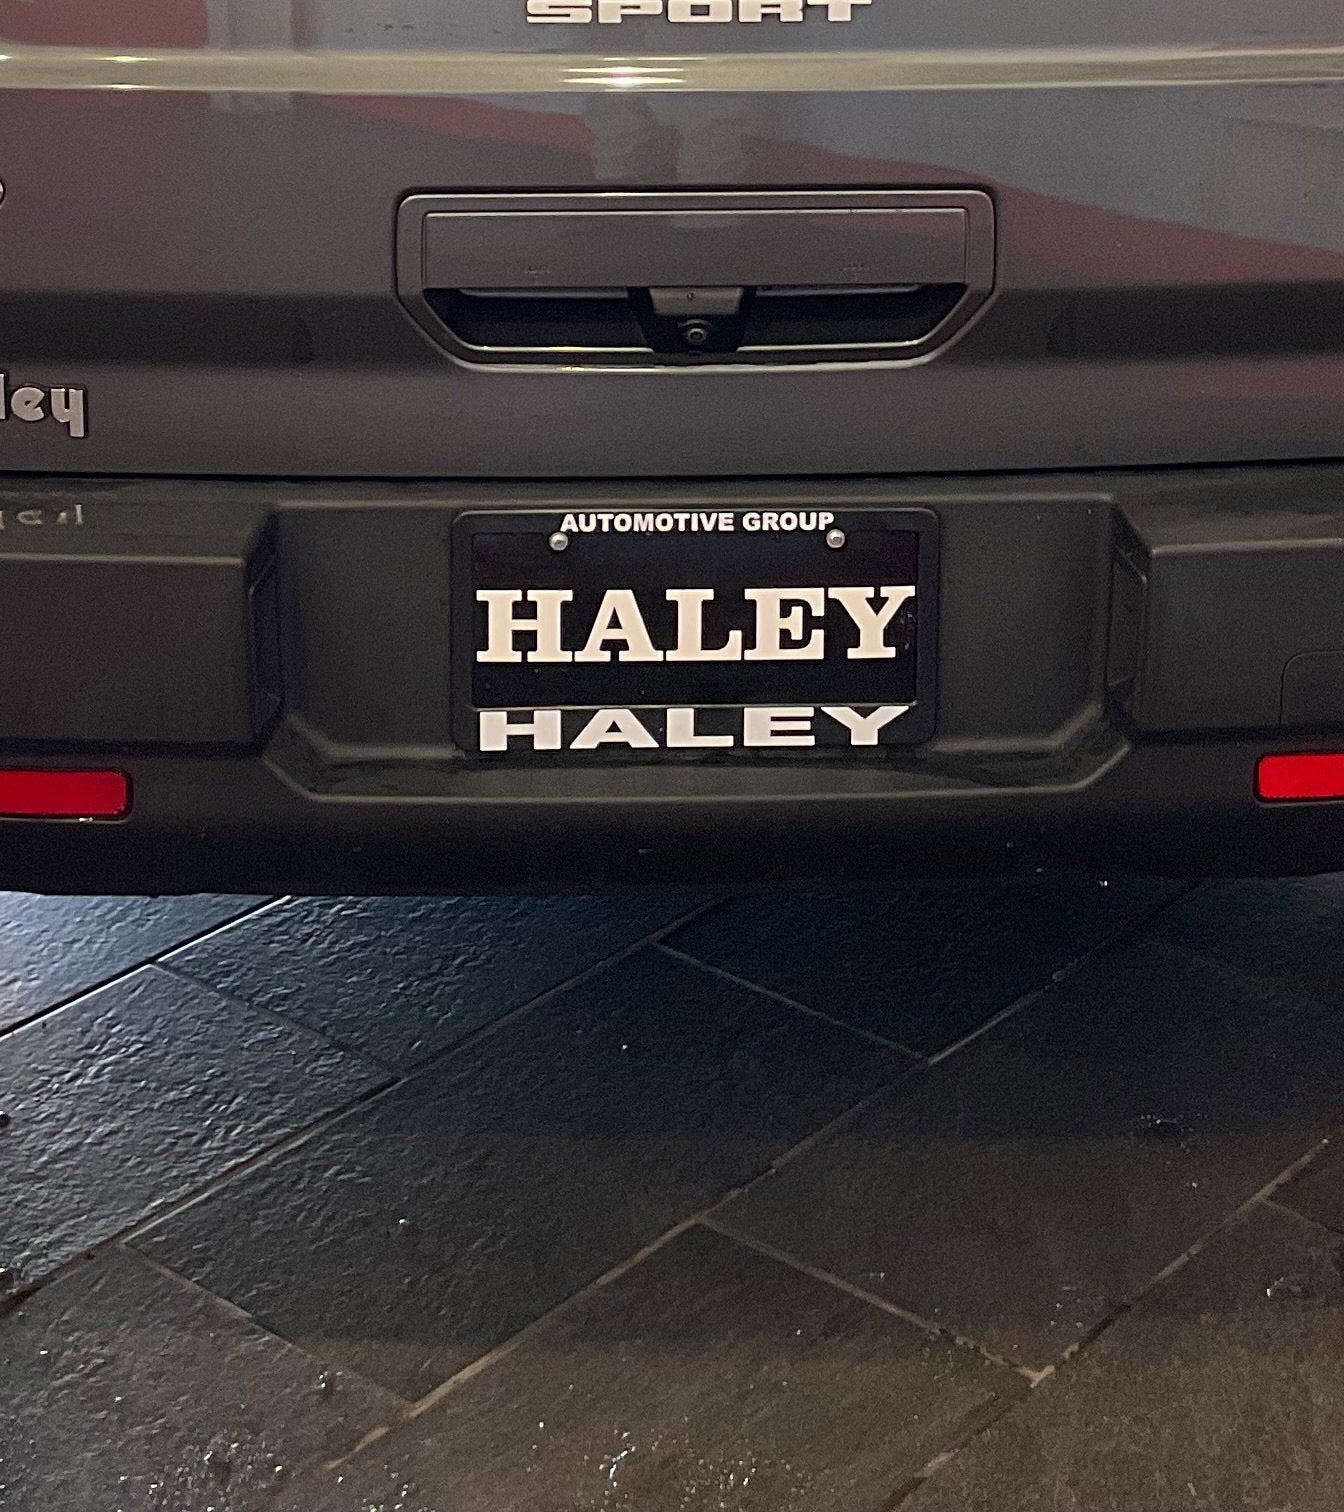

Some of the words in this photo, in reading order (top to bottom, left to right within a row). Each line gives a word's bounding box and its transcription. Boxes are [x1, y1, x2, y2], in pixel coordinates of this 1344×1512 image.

[560, 511, 735, 533] AUTOMOTIVE
[742, 511, 836, 532] GROUP
[475, 584, 917, 664] HALEY
[479, 704, 912, 752] HALEY
